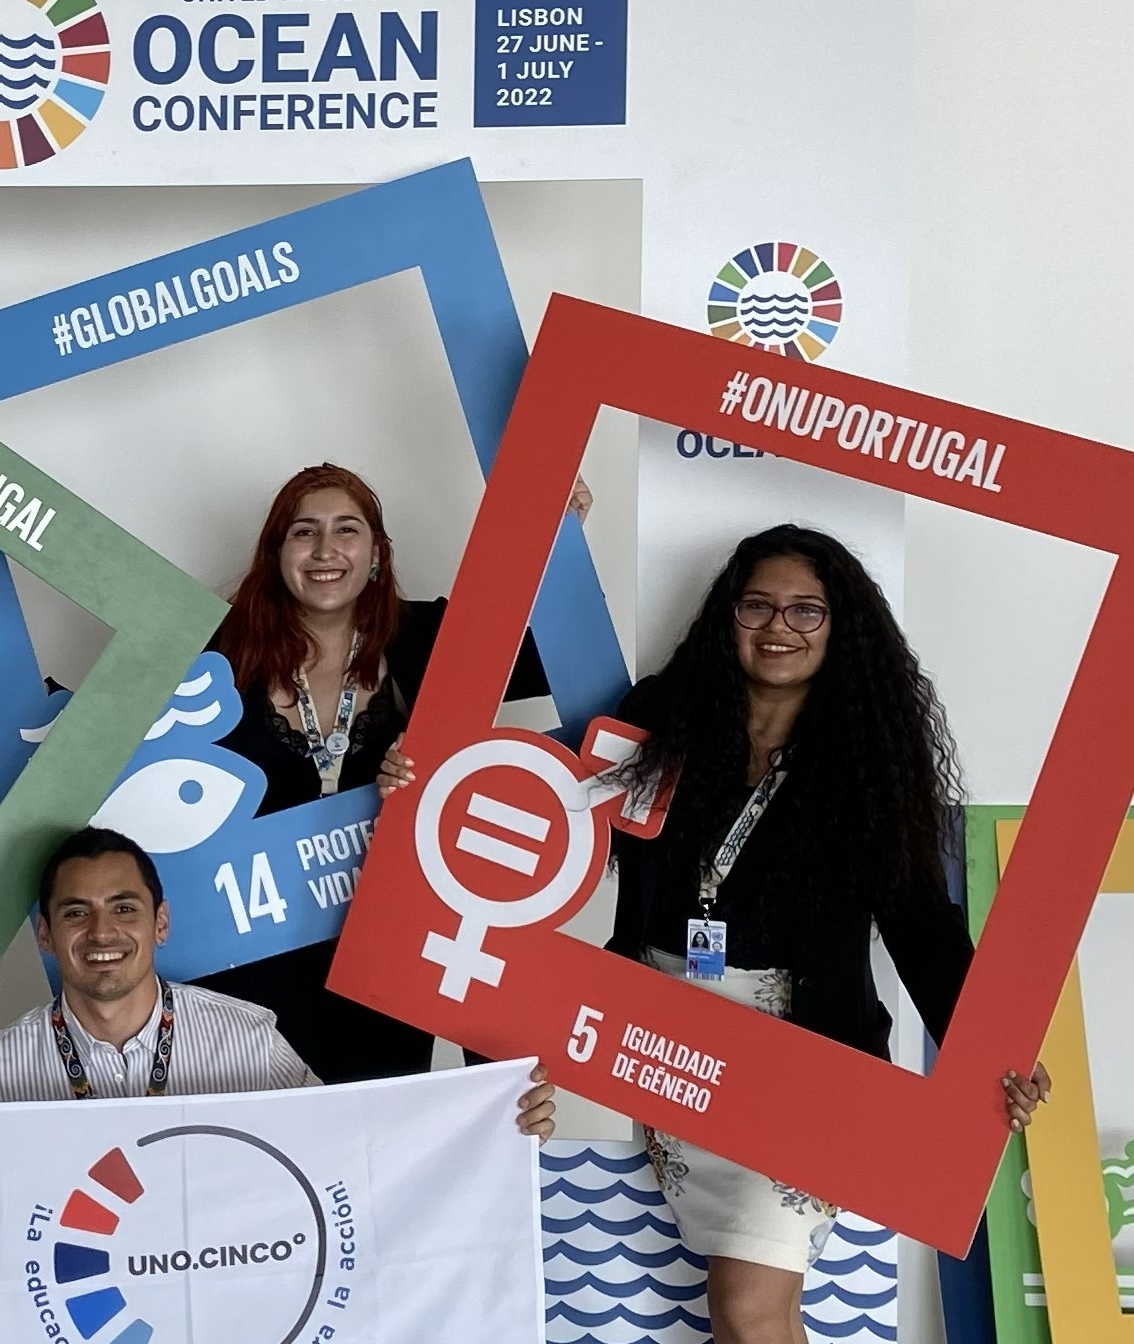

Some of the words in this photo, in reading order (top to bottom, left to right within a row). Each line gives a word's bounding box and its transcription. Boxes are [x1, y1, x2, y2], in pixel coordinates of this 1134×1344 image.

[496, 7, 584, 28] LISBON
[496, 35, 523, 54] 27
[528, 32, 590, 54] JUNE
[132, 10, 439, 86] OCEAN
[496, 62, 507, 80] 1
[516, 60, 575, 81] JULY
[132, 91, 438, 133] CONFERENCE
[496, 87, 553, 108] 2022
[52, 240, 301, 357] #GLOBALGOALS
[718, 369, 1008, 494] #ONUPORTUGAL
[295, 816, 381, 871] PROTE
[213, 851, 288, 936] 14
[566, 1004, 605, 1063] 5
[621, 1022, 727, 1086] IGUALDADE
[611, 1052, 641, 1084] DE
[325, 1179, 356, 1271] acción!
[326, 1286, 351, 1310] la
